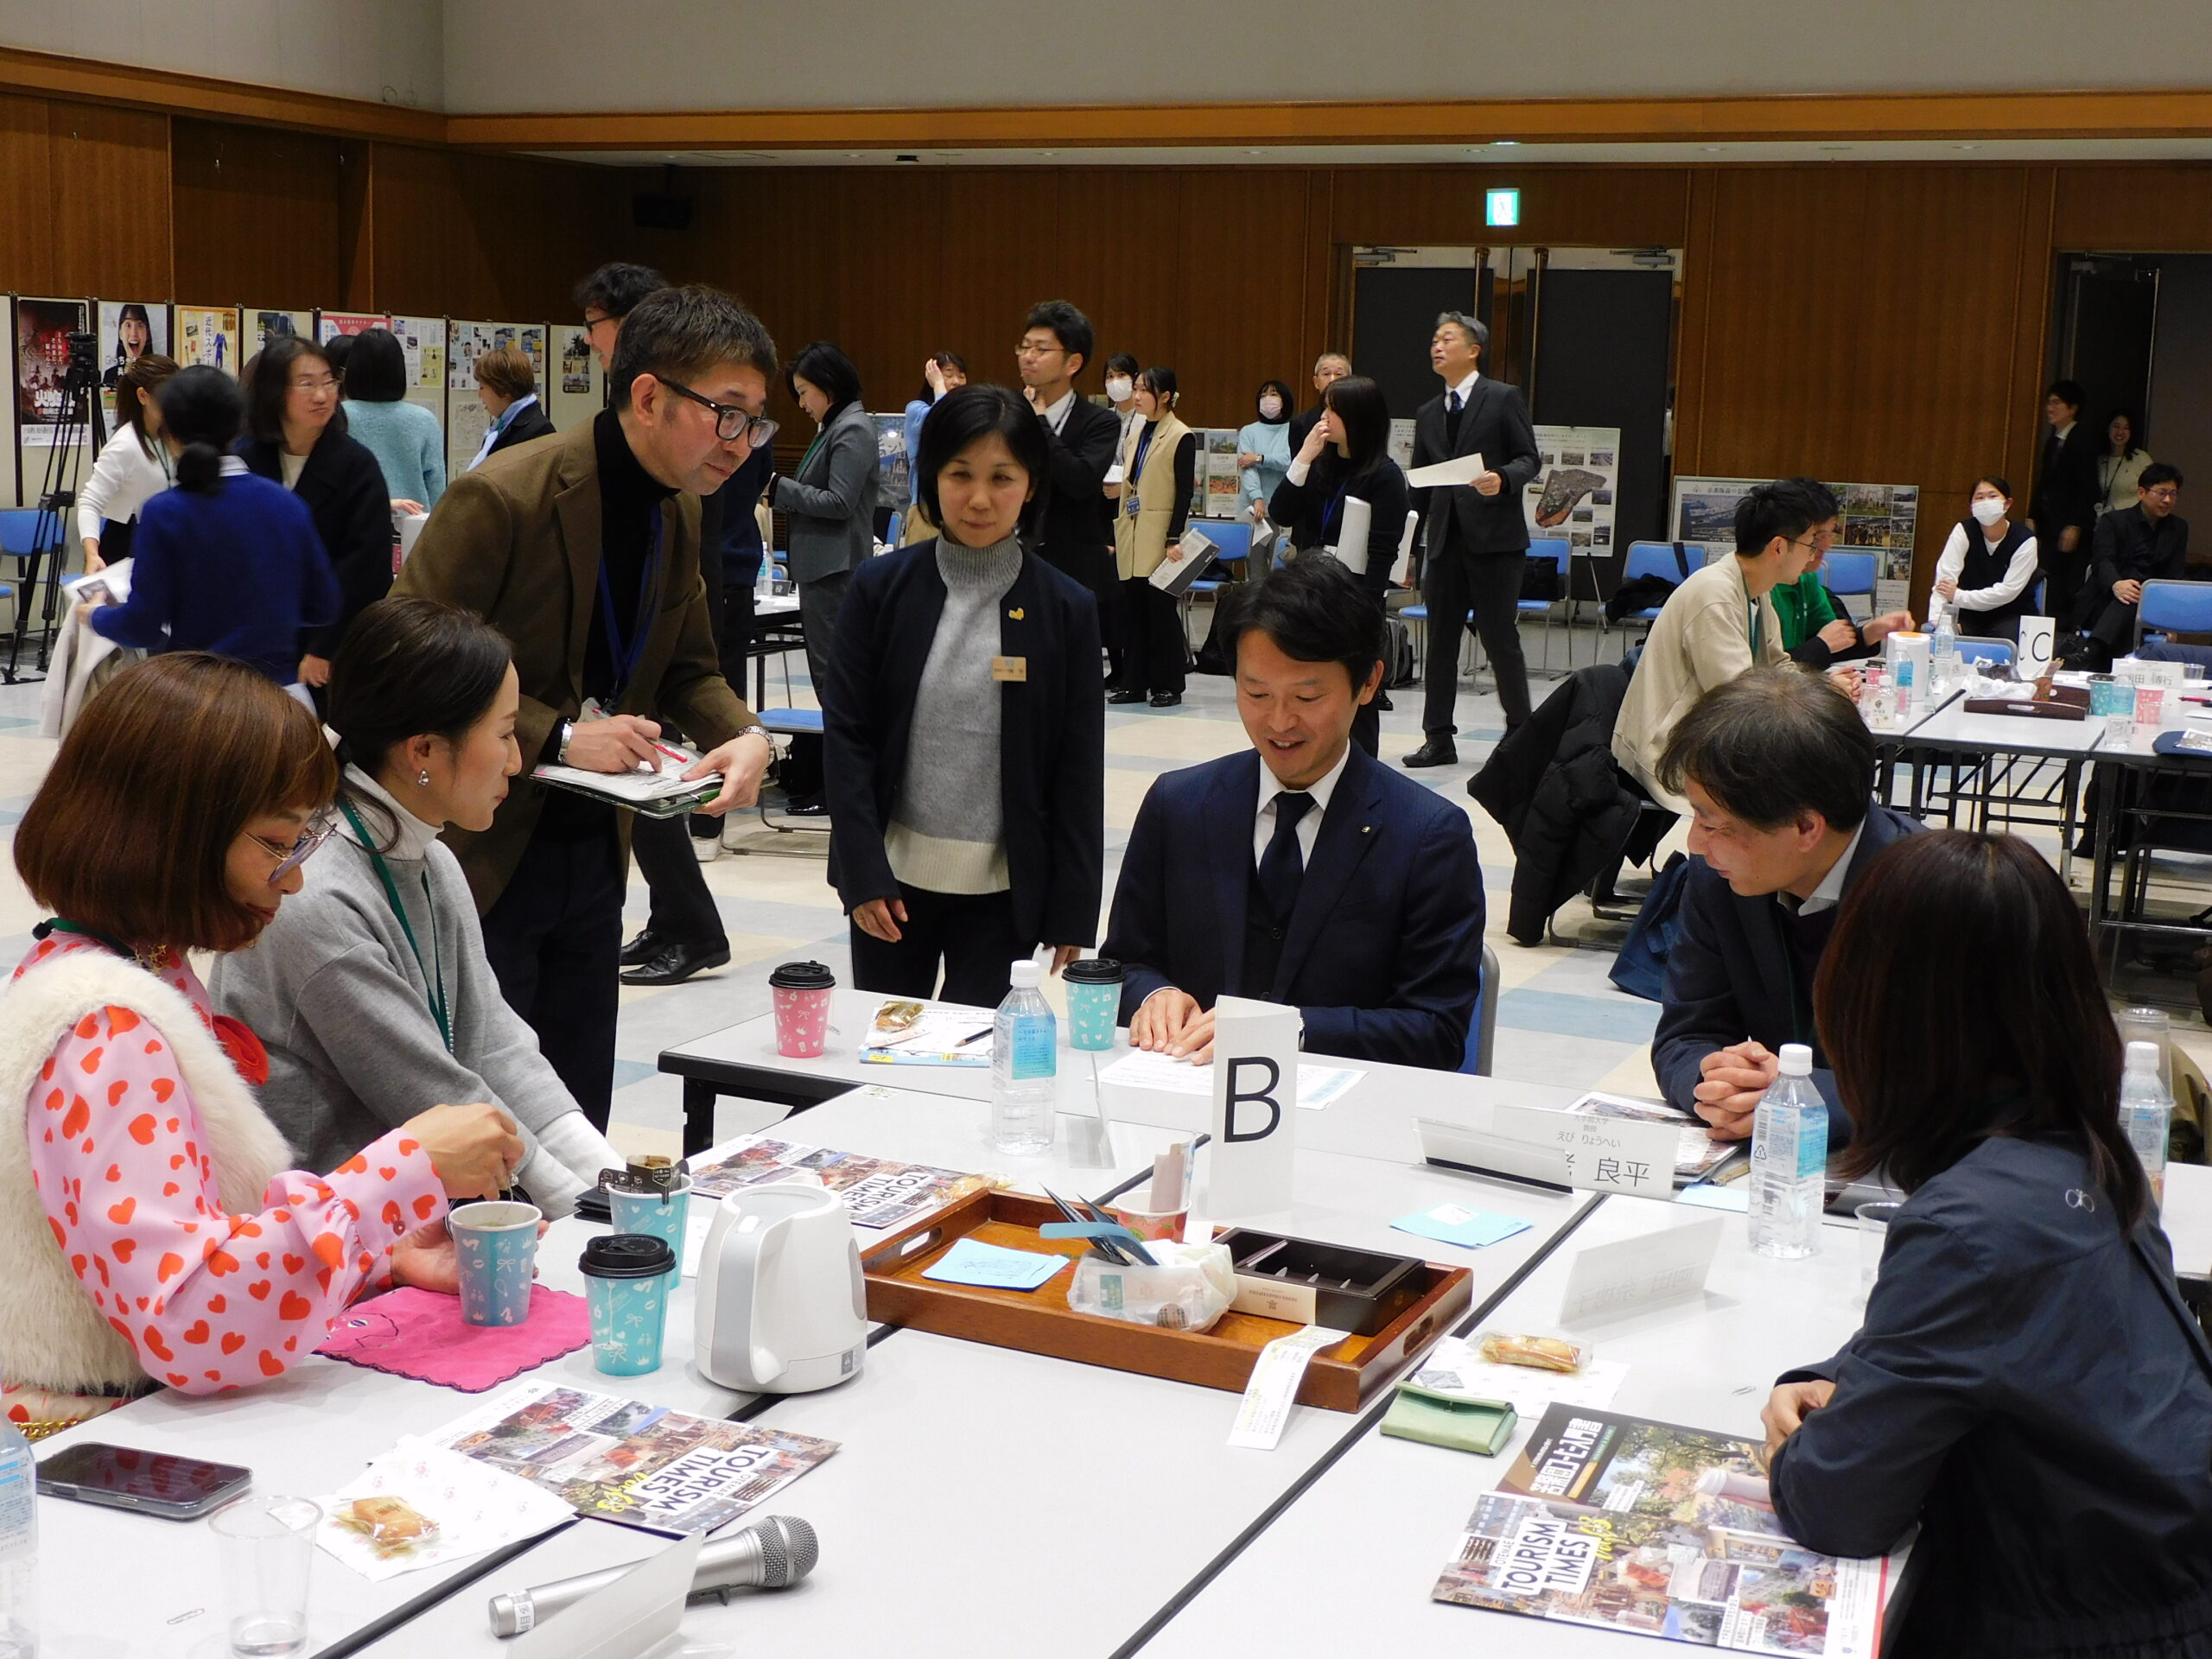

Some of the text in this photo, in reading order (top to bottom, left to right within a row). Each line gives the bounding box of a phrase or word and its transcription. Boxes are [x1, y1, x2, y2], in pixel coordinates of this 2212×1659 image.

[2032, 632, 2051, 662] C
[1224, 1056, 1281, 1143] B
[1556, 1130, 1621, 1148] えび りょうへい
[1593, 1156, 1650, 1188] 良平
[845, 1174, 929, 1211] TOURISM
[641, 1453, 724, 1494] TIMES
[649, 1449, 772, 1511] TOURISM
[713, 1474, 752, 1497] OTEMAE
[1494, 1537, 1515, 1566] OTEMAE
[1500, 1522, 1560, 1591] TOURISM
[1544, 1539, 1592, 1586] TIMES
